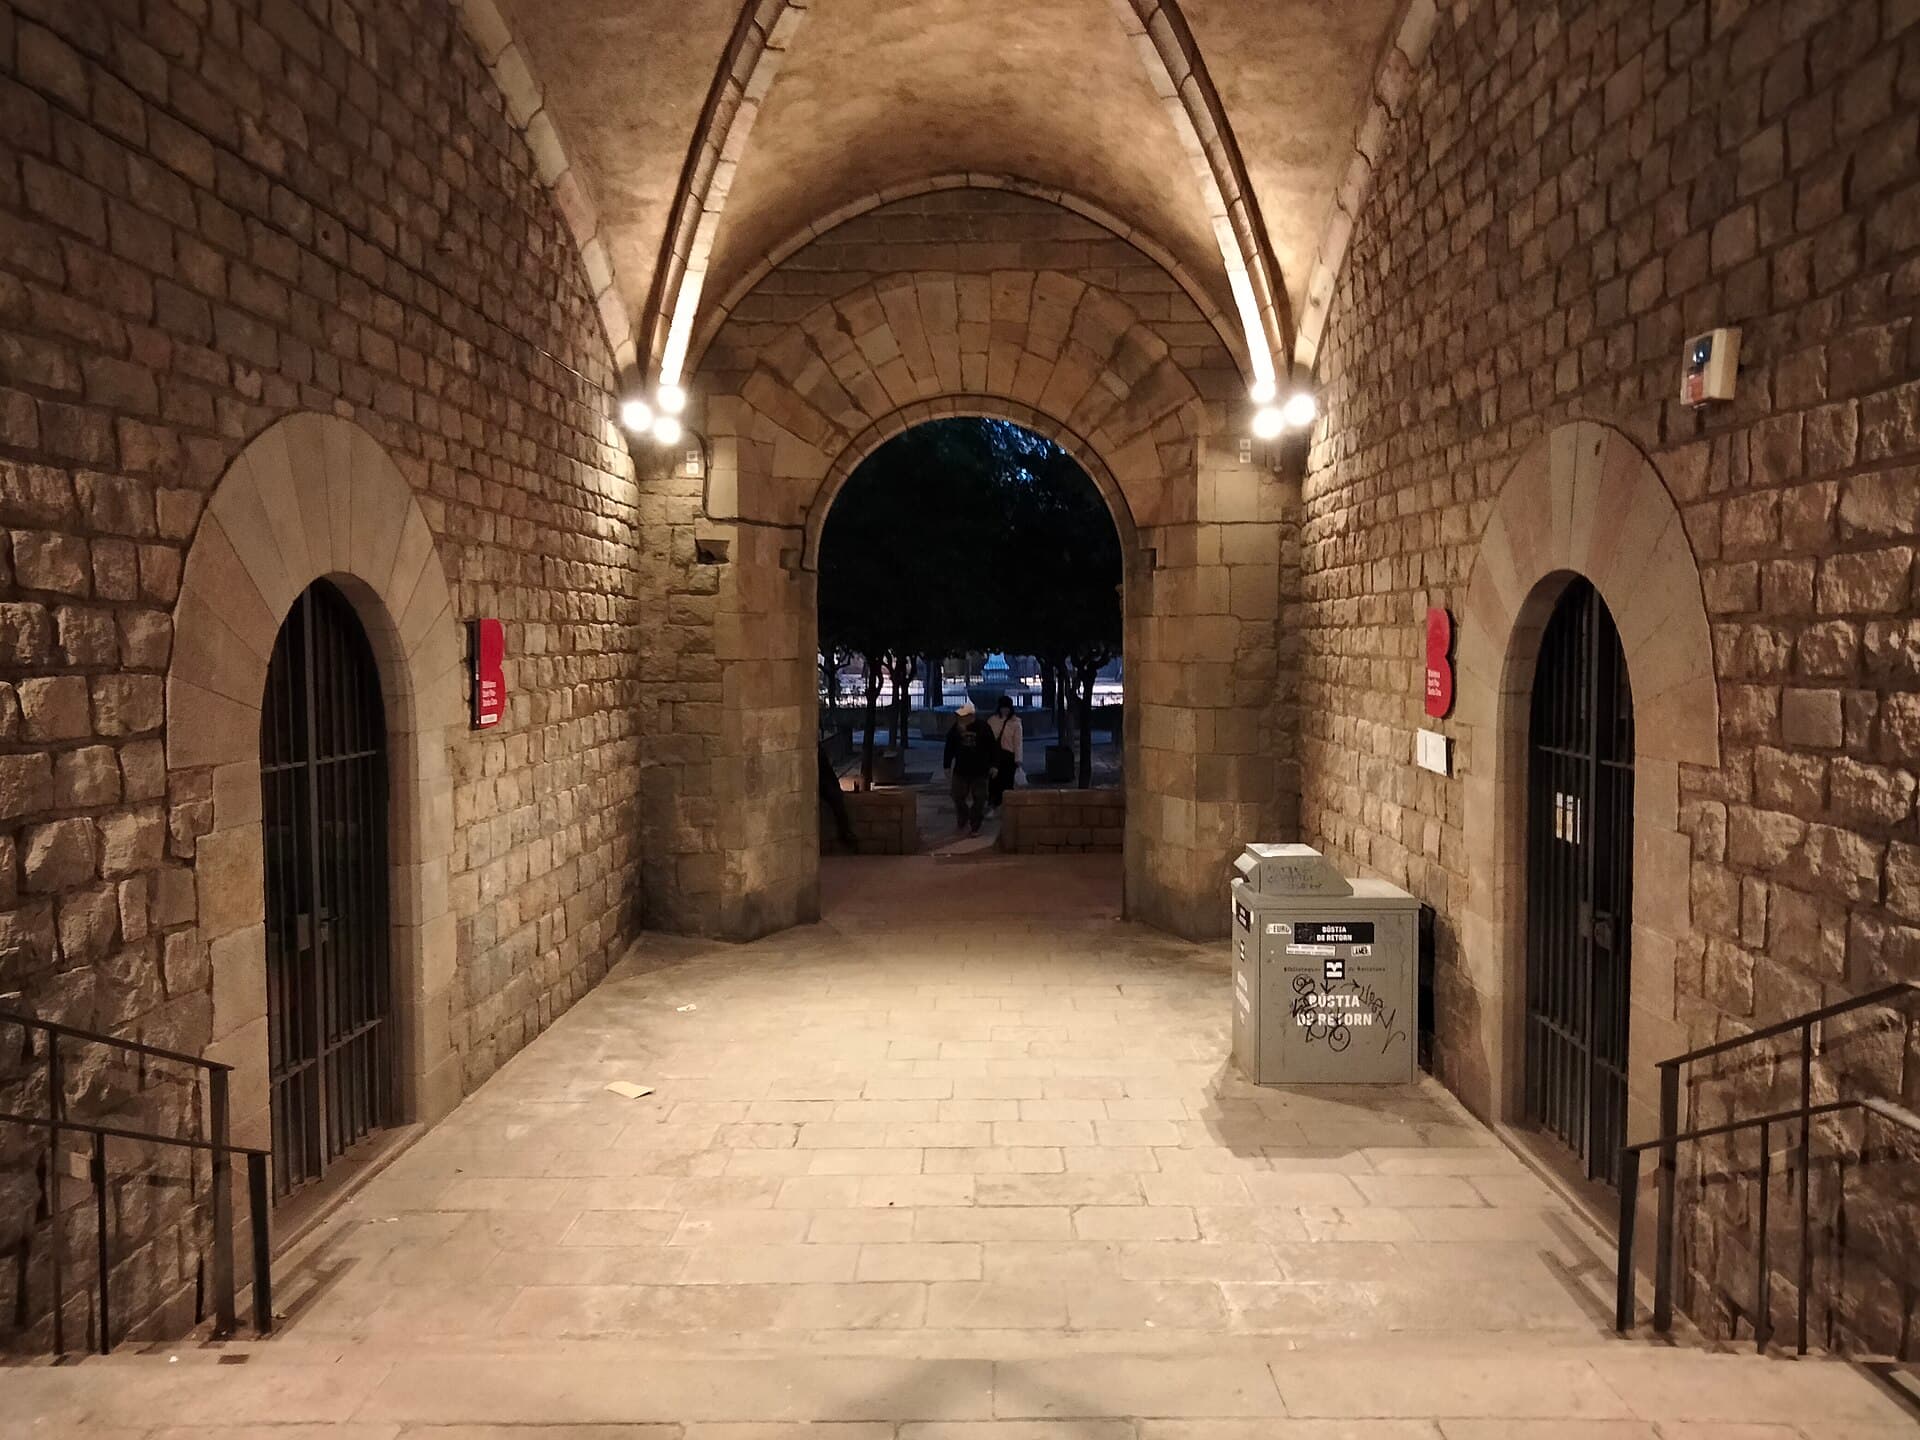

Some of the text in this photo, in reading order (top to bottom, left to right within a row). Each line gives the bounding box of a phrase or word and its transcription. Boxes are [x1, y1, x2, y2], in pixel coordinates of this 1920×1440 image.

[1321, 924, 1347, 933] BÚSTIA
[1326, 934, 1353, 942] RETORN
[1308, 992, 1360, 1008] BÚSTIA
[1318, 1013, 1372, 1026] RETORN
